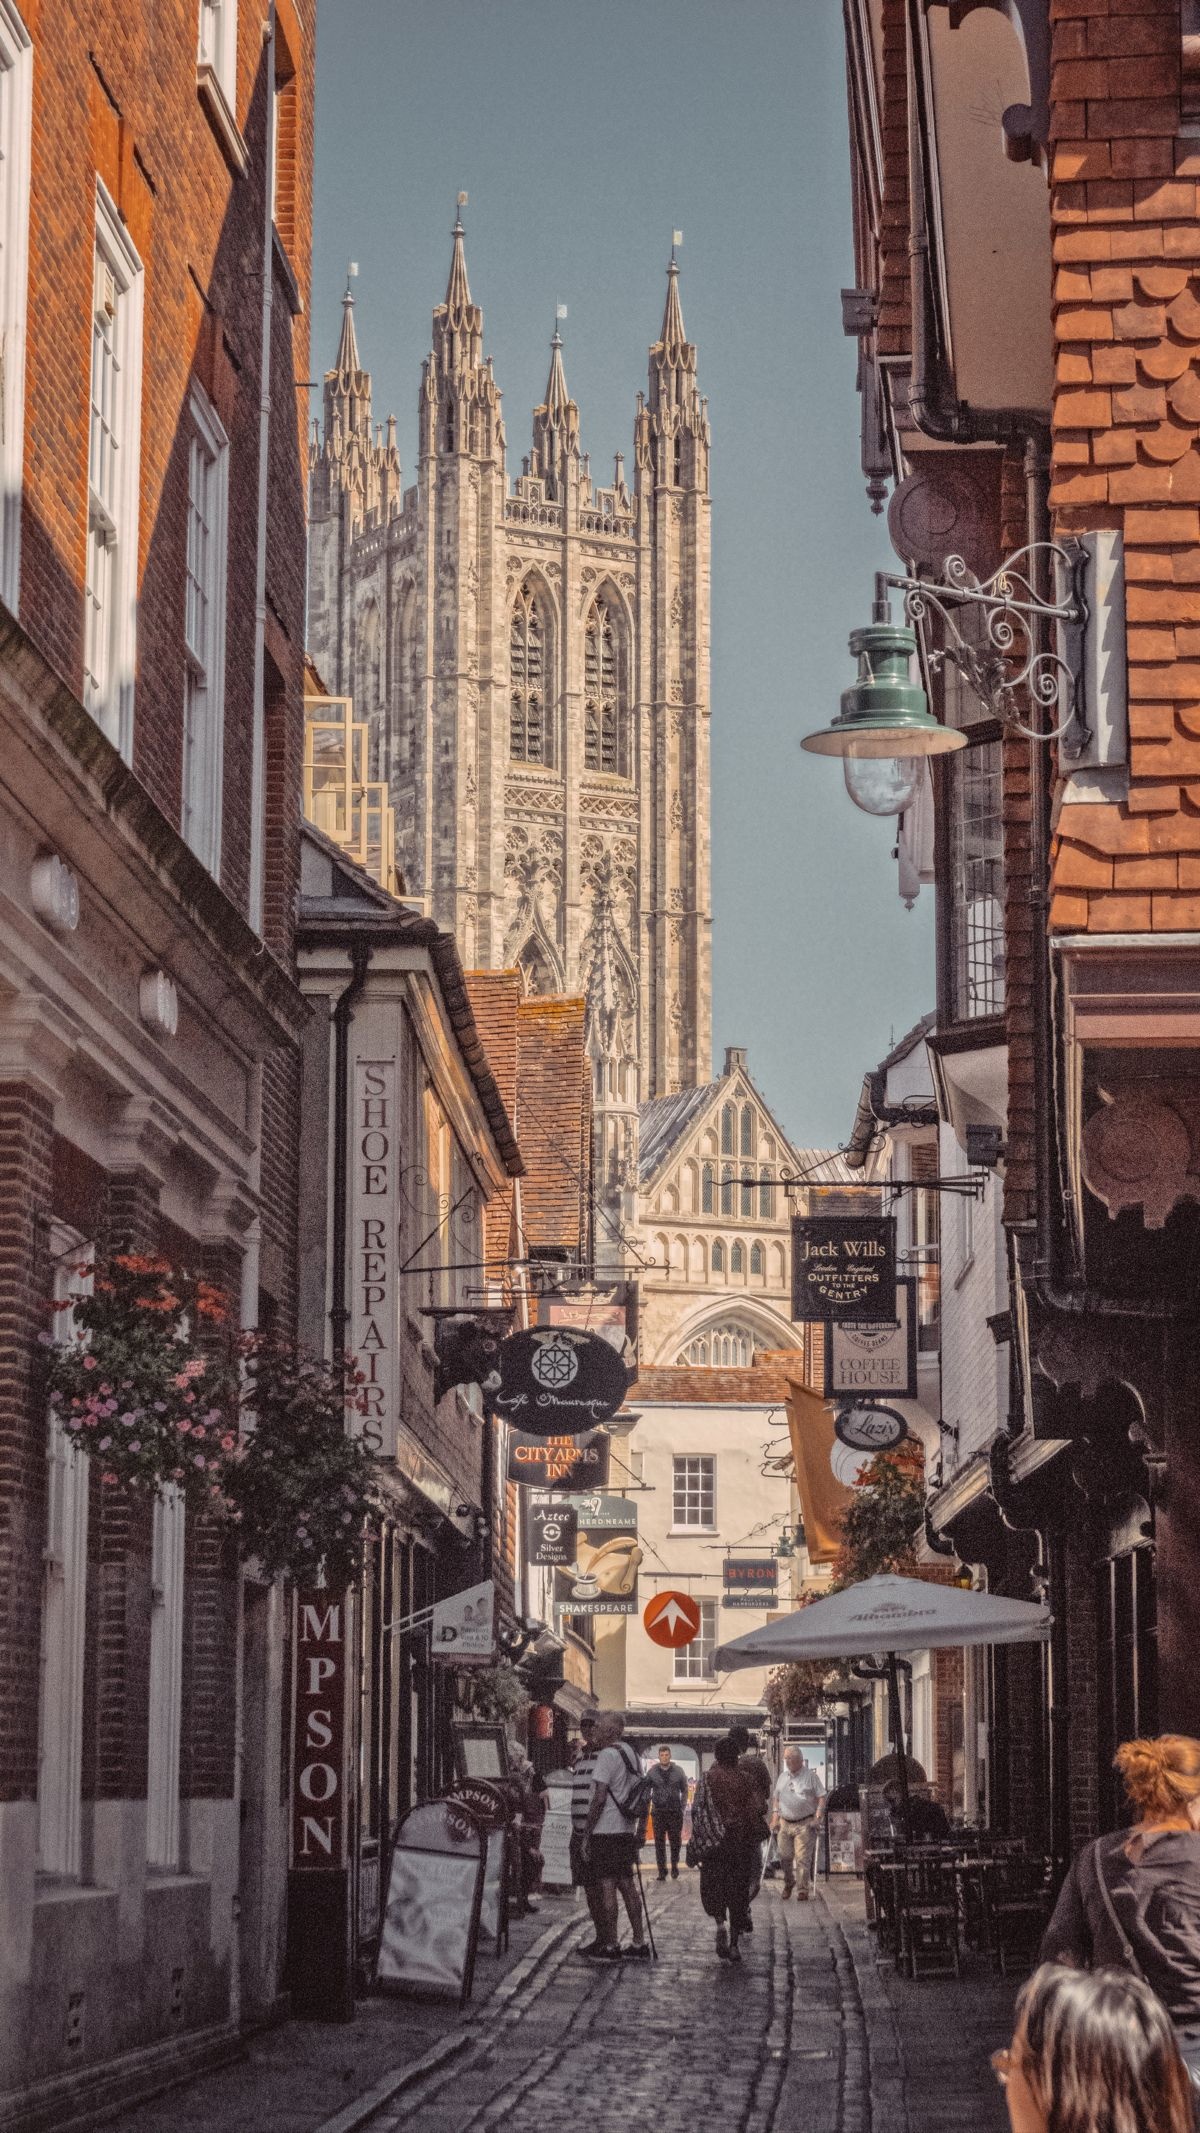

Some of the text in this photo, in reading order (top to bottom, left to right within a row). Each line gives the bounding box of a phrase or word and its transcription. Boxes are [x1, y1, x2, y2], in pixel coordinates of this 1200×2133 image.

[360, 1065, 389, 1195] SHOE
[802, 1241, 886, 1261] Jack Wills
[807, 1273, 880, 1282] OUTFITTERS
[819, 1285, 868, 1300] GENTRY
[358, 1219, 388, 1451] REPAIRS
[840, 1358, 900, 1370] COFFEE
[840, 1371, 900, 1384] HOUSE
[546, 1436, 573, 1446] THE
[515, 1446, 598, 1462] CITY ARMS
[546, 1463, 574, 1477] INN
[534, 1509, 570, 1521] Aztec
[540, 1544, 563, 1552] Silver
[536, 1552, 567, 1562] Designs
[727, 1568, 776, 1578] BYRON
[559, 1604, 633, 1613] SHAKESPEARE
[849, 1609, 936, 1621] Alhambra
